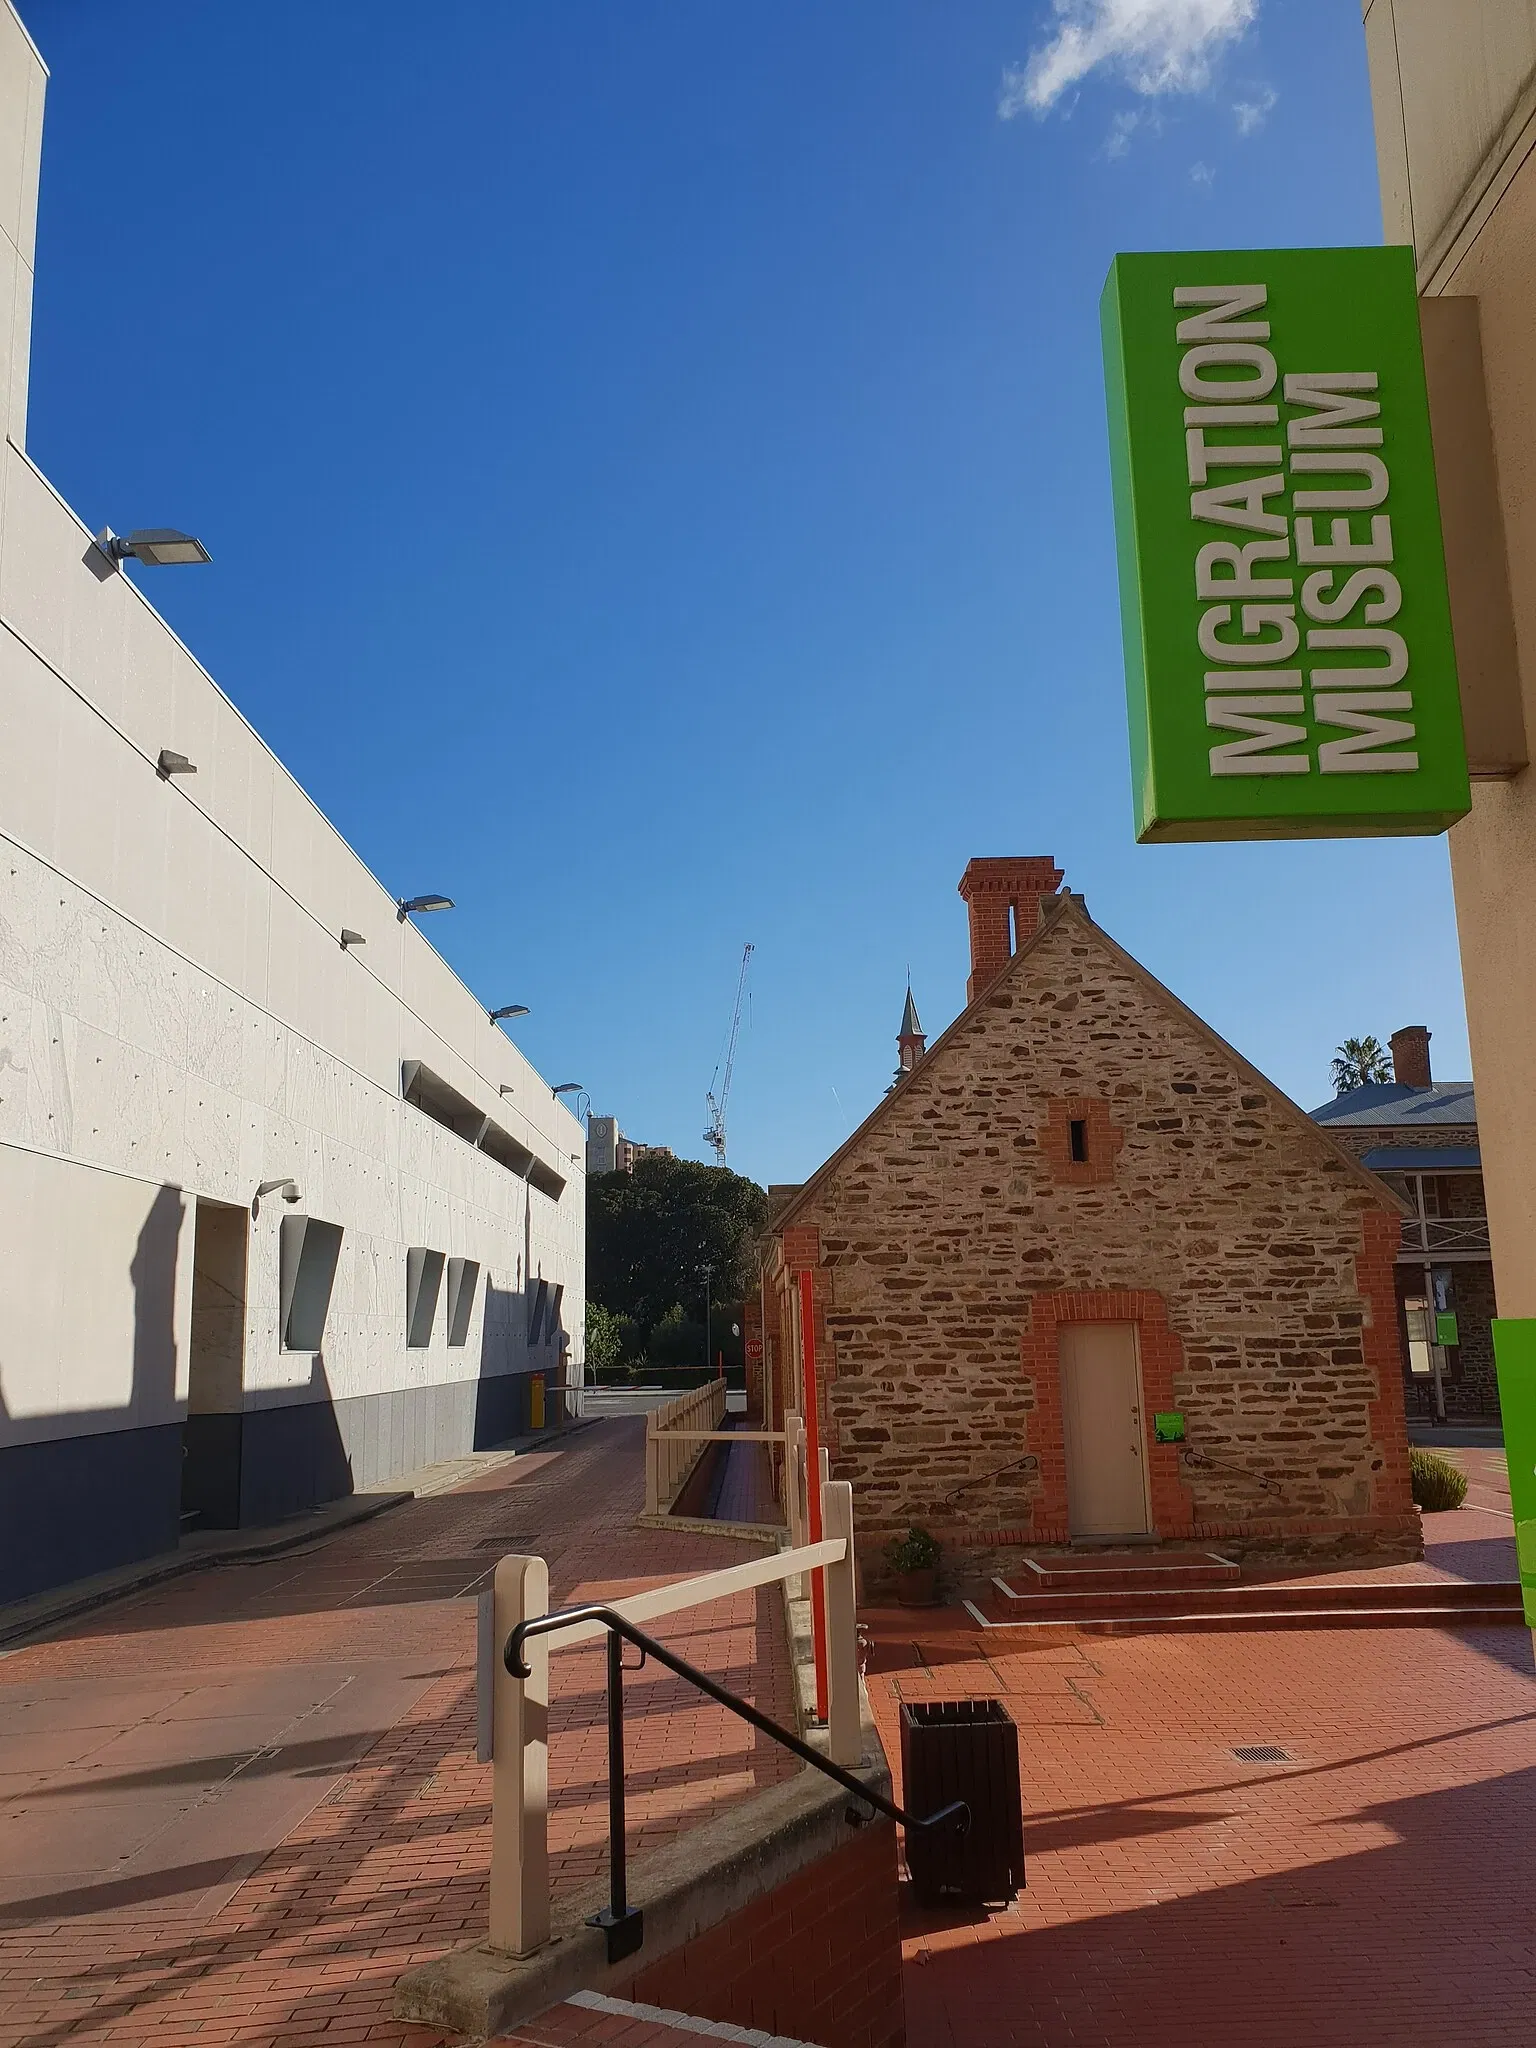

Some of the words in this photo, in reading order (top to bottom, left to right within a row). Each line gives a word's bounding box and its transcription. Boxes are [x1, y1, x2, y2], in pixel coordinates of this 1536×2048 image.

[1173, 283, 1311, 776] MIGRATION
[1283, 371, 1420, 775] MUSEUM
[747, 1344, 763, 1353] STOP
